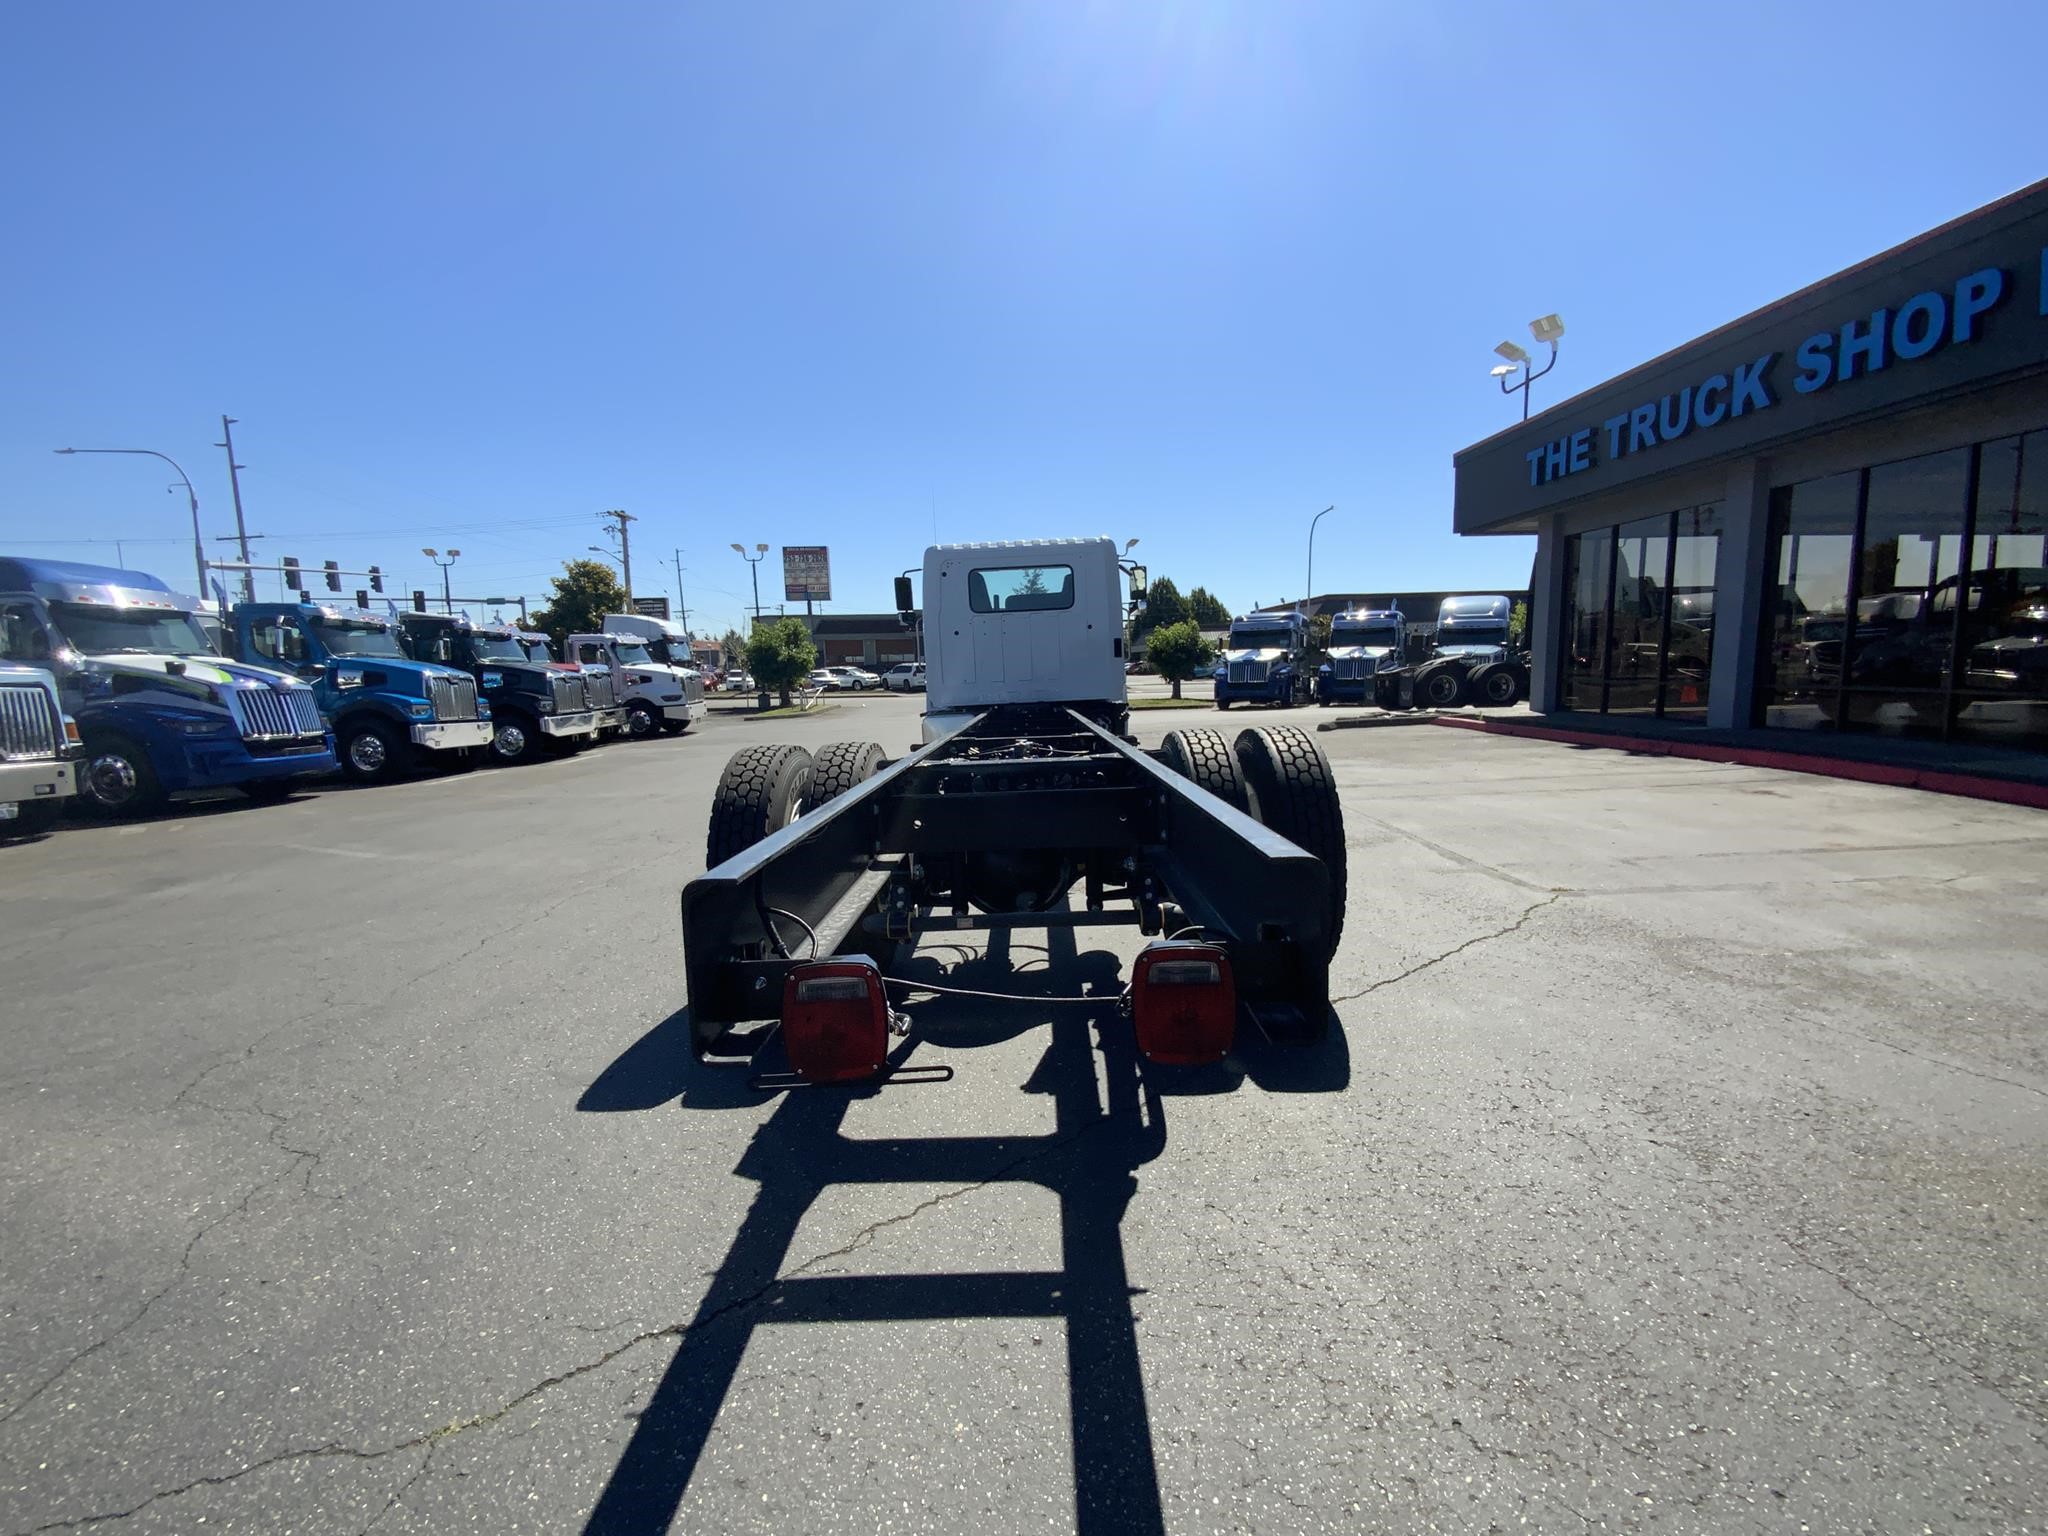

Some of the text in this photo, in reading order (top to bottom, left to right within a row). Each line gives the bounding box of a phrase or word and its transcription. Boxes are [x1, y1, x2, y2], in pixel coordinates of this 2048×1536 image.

[1525, 428, 1592, 487] THE
[1603, 354, 1775, 460] TRUCK
[1793, 267, 2004, 394] SHOP
